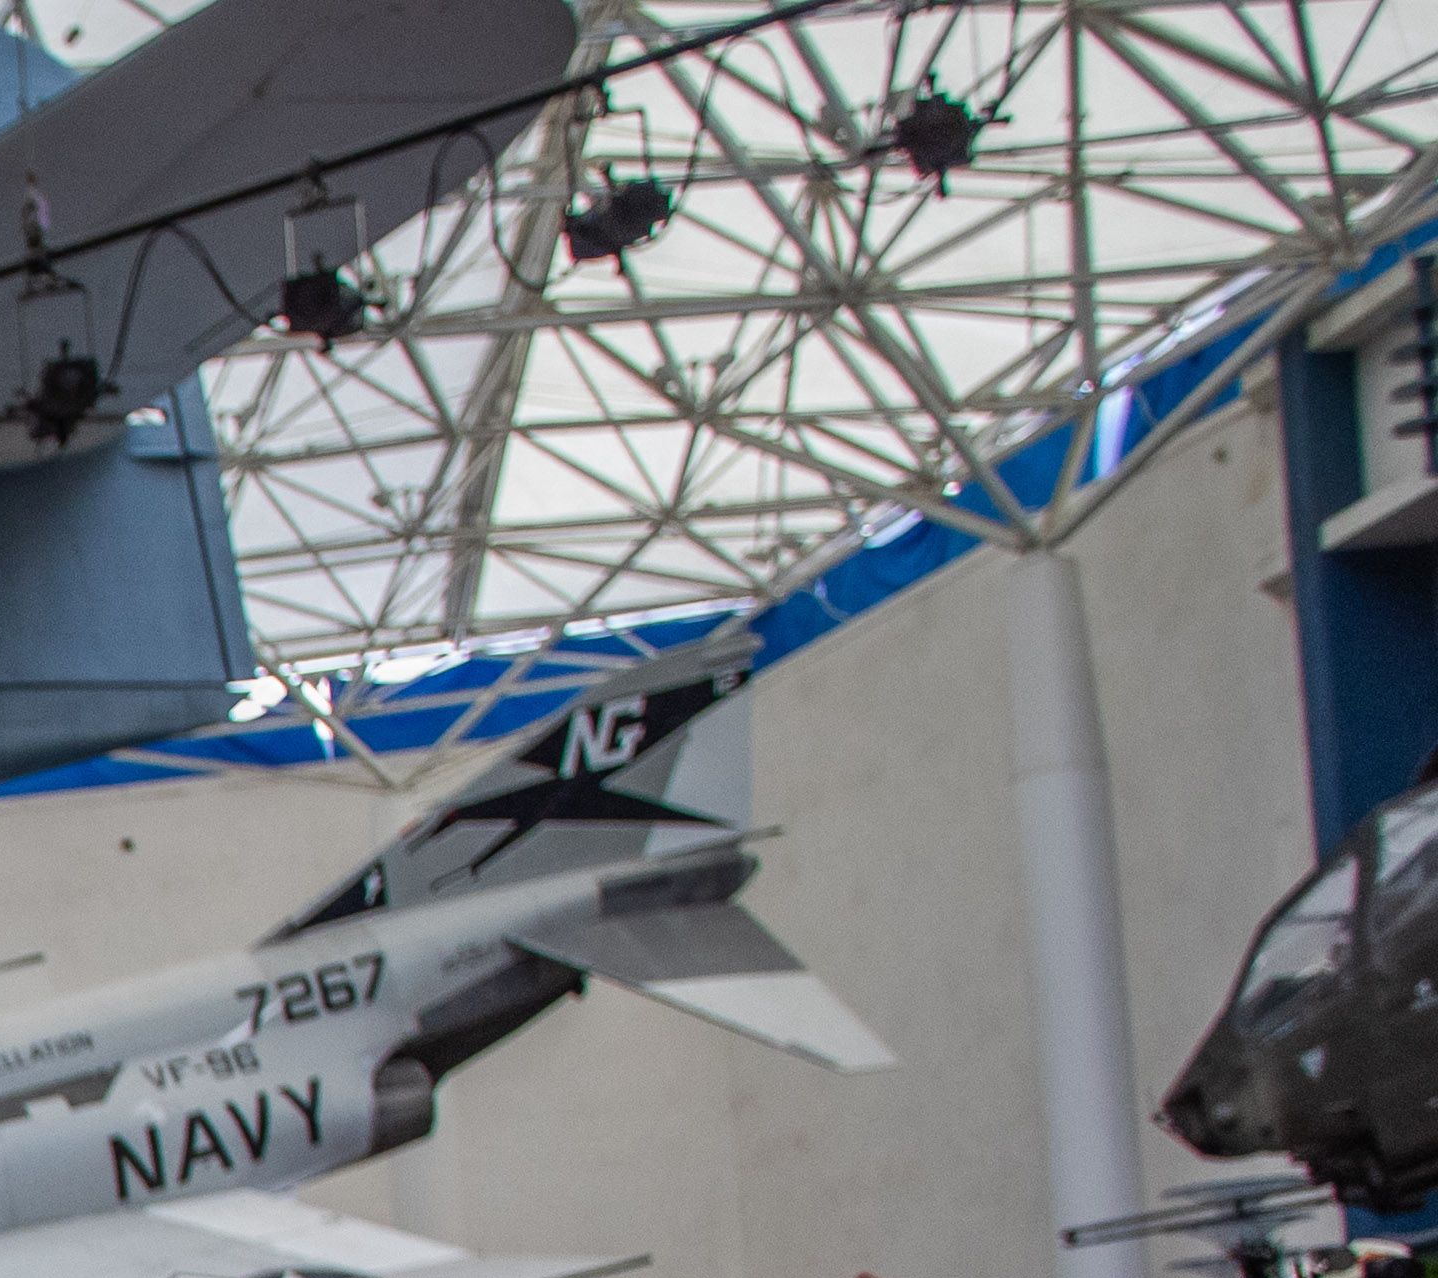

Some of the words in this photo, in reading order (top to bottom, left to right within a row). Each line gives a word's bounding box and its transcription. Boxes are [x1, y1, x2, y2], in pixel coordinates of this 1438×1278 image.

[558, 693, 646, 778] NG
[236, 951, 384, 1036] 7267
[141, 1041, 260, 1090] VF-96
[109, 1075, 323, 1200] NAVY
